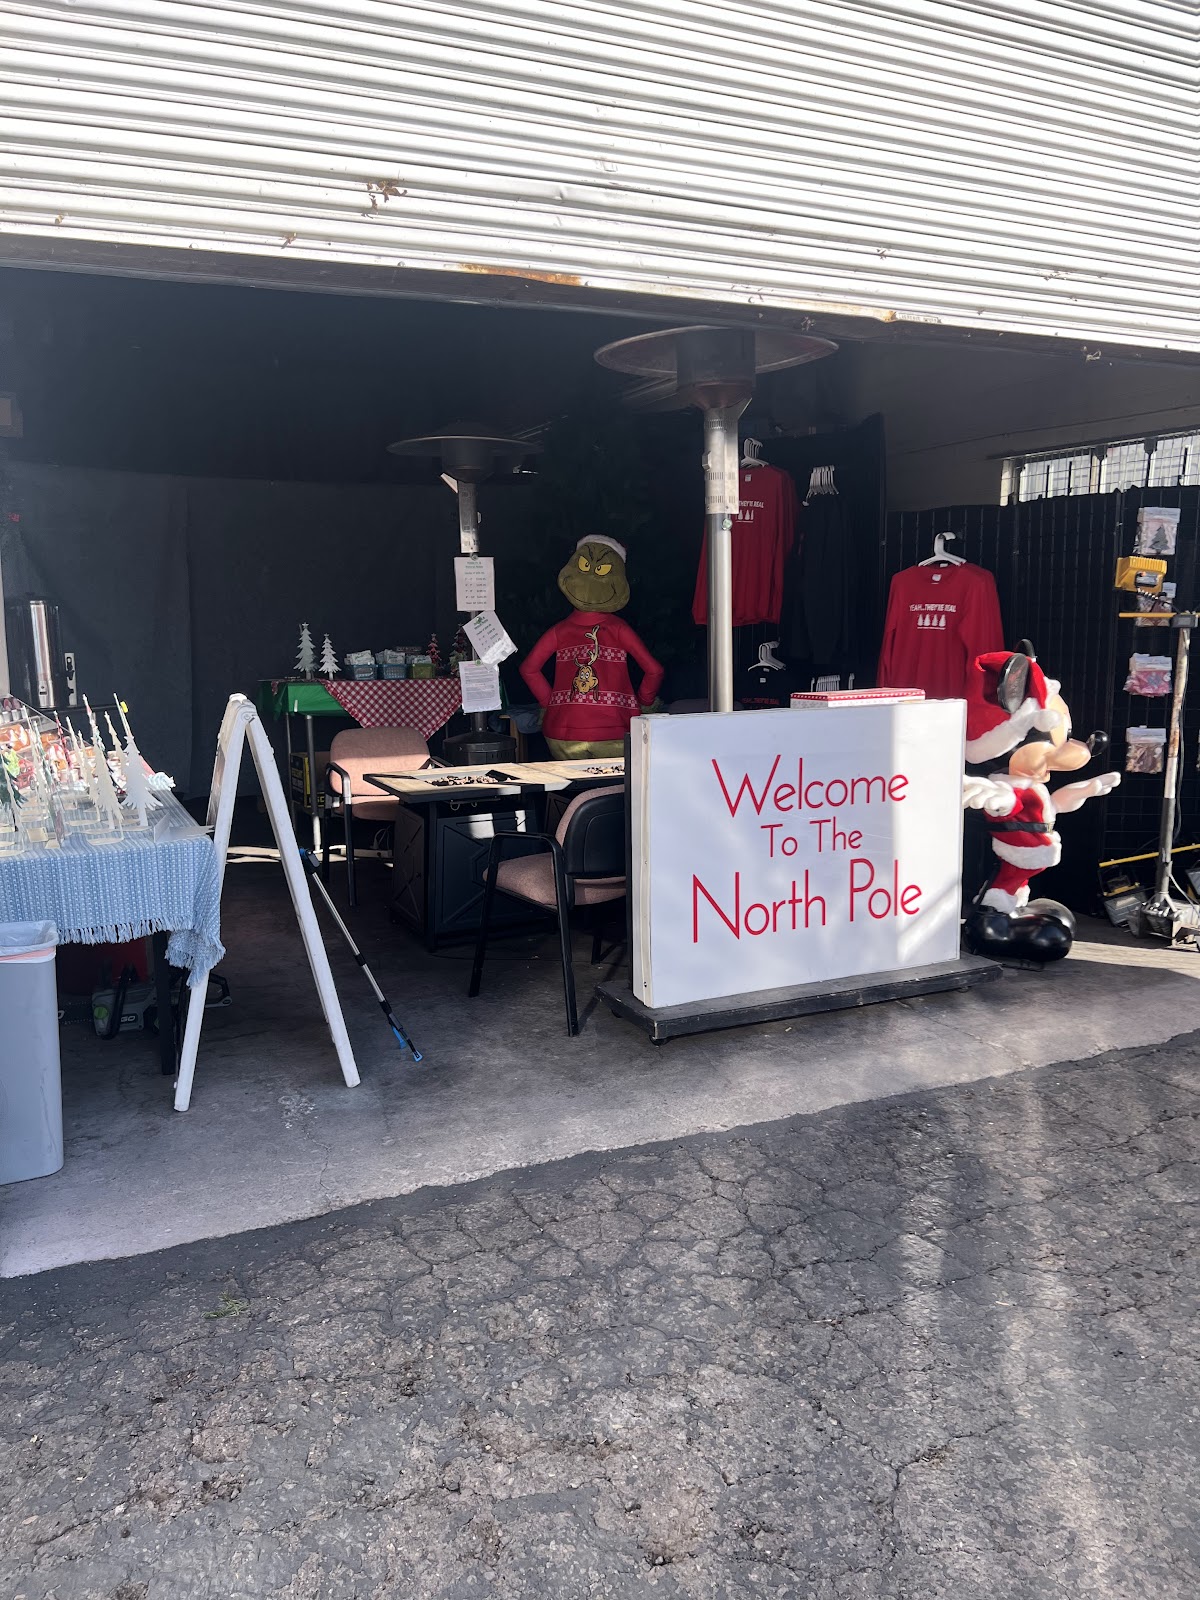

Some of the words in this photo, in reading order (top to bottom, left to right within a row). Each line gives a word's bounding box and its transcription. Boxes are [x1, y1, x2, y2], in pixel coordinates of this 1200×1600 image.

[711, 754, 909, 818] Welcome
[761, 823, 799, 858] To
[810, 816, 863, 853] The
[692, 869, 826, 944] North
[848, 858, 922, 923] Pole
